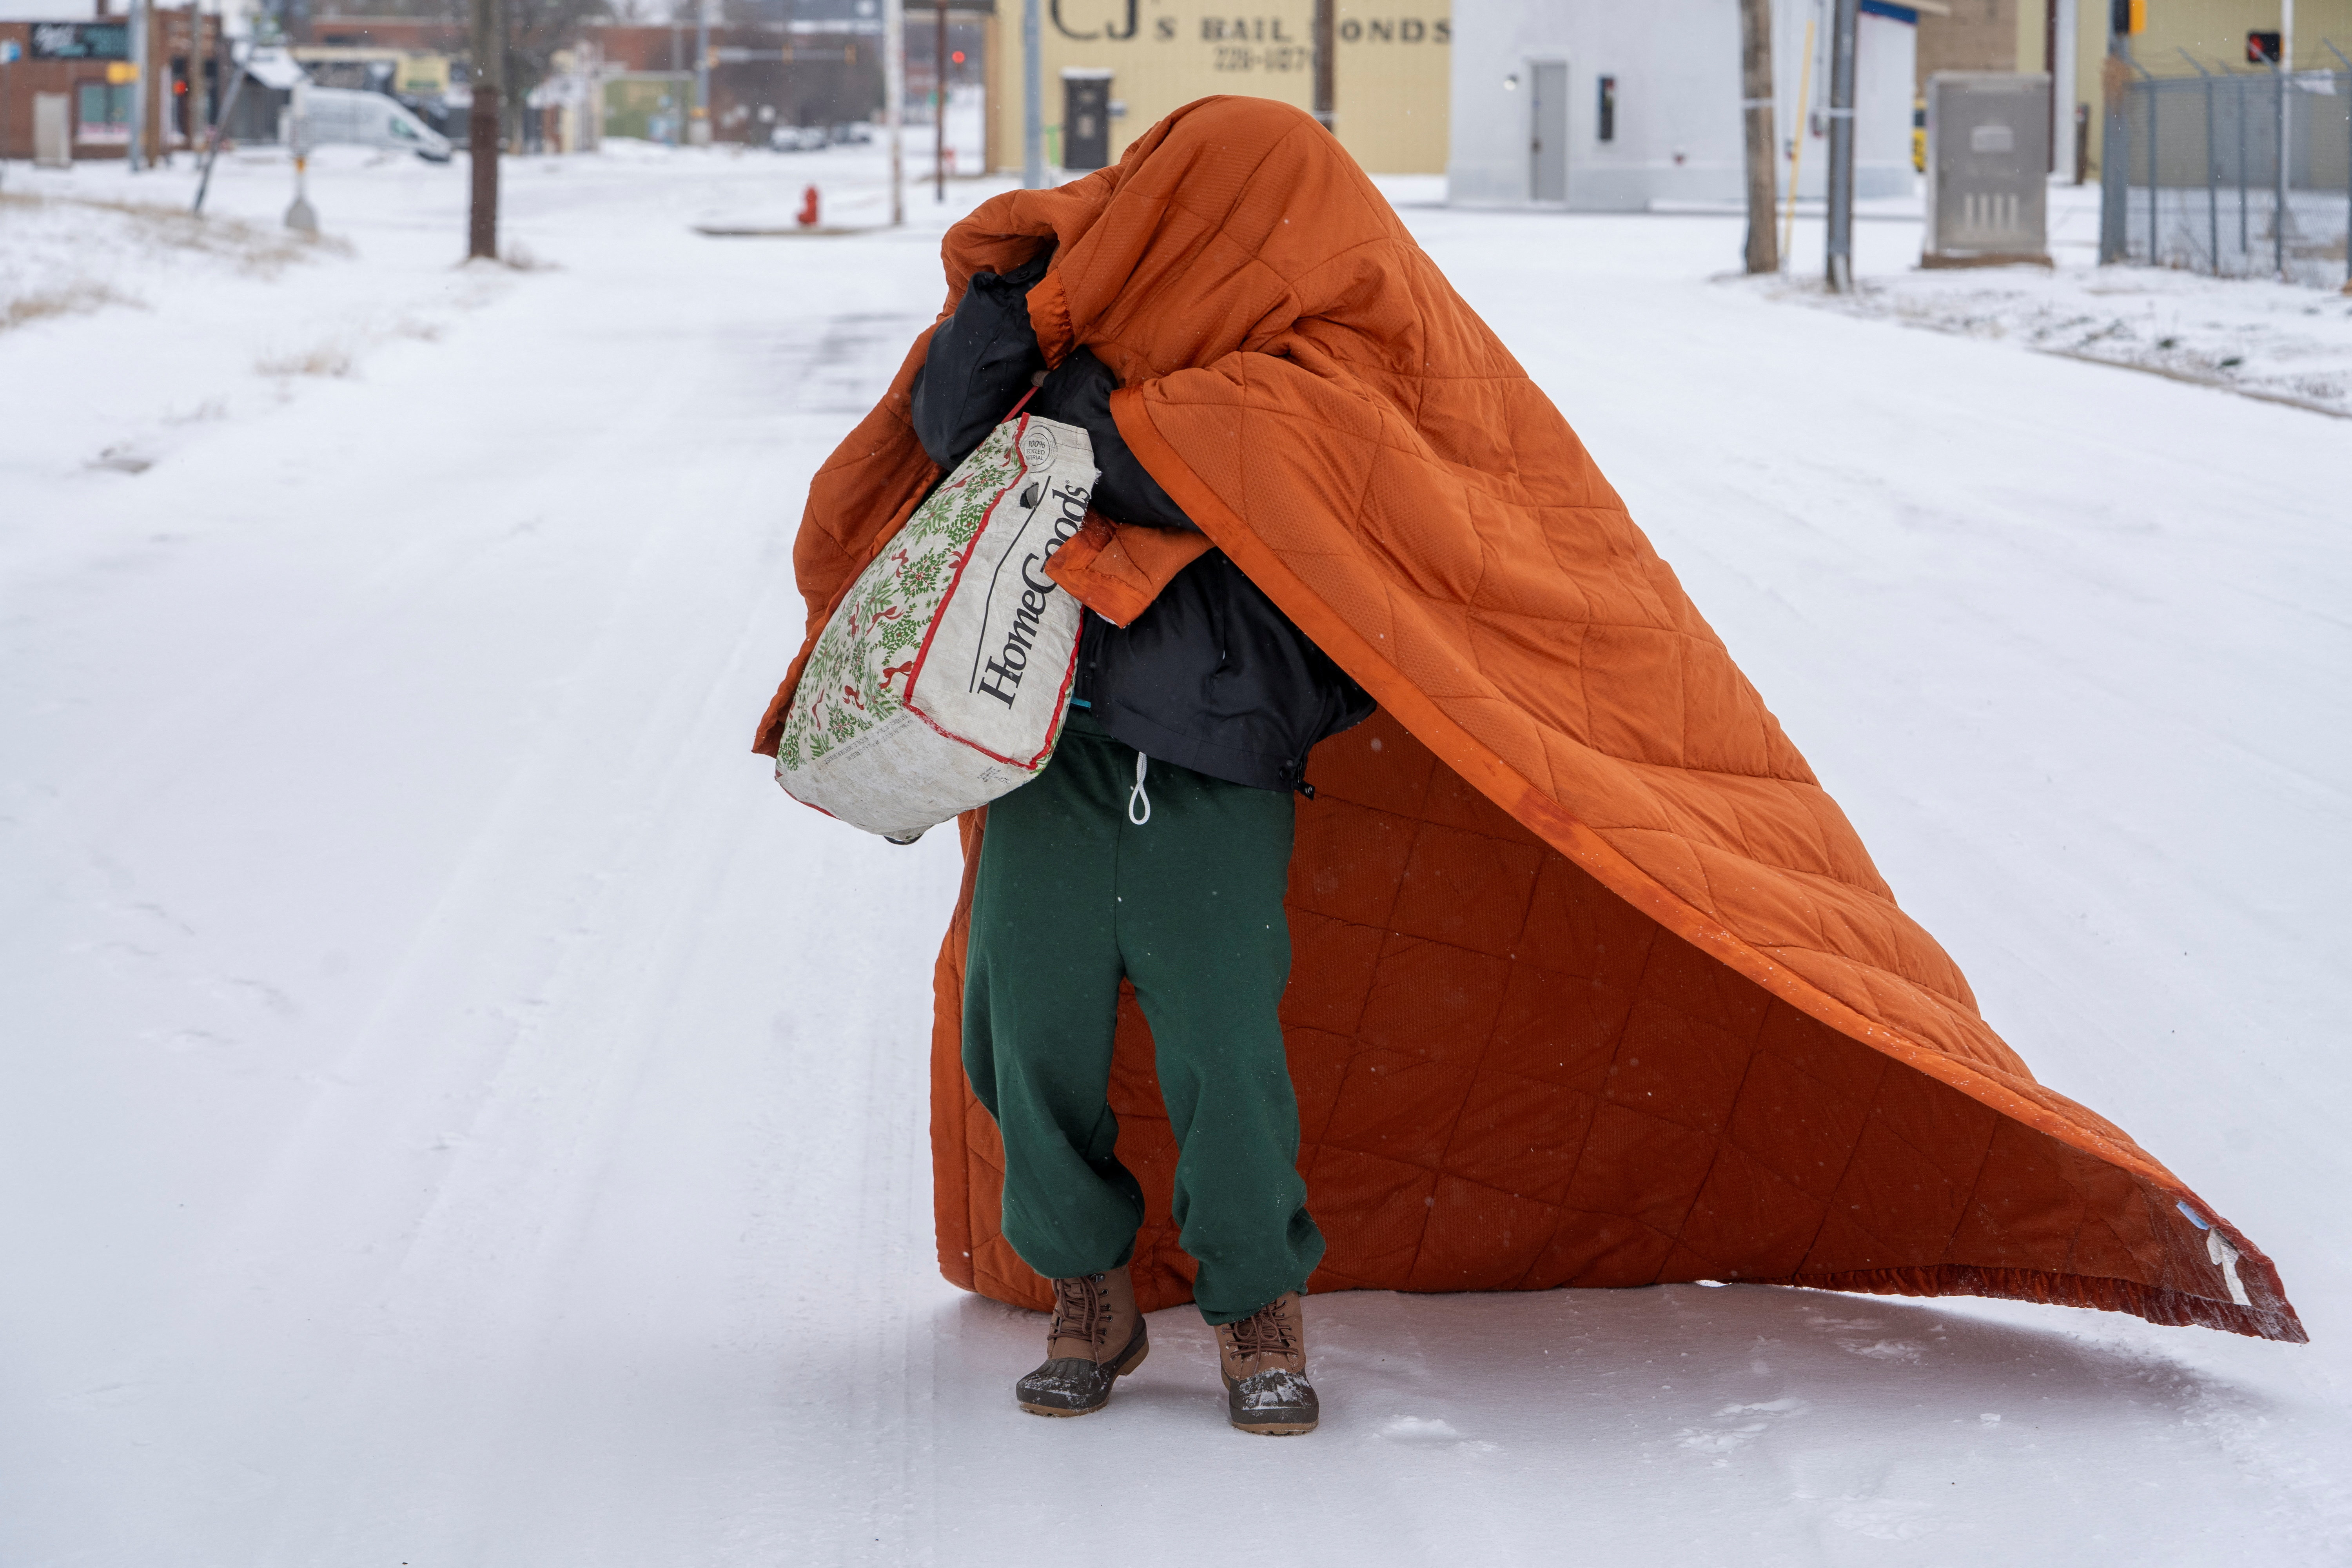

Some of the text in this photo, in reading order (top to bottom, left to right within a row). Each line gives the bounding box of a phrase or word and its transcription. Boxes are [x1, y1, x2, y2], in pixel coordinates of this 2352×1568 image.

[1201, 17, 1294, 42] BAIL
[1310, 18, 1453, 44] ONDS
[1028, 440, 1045, 448] 100%
